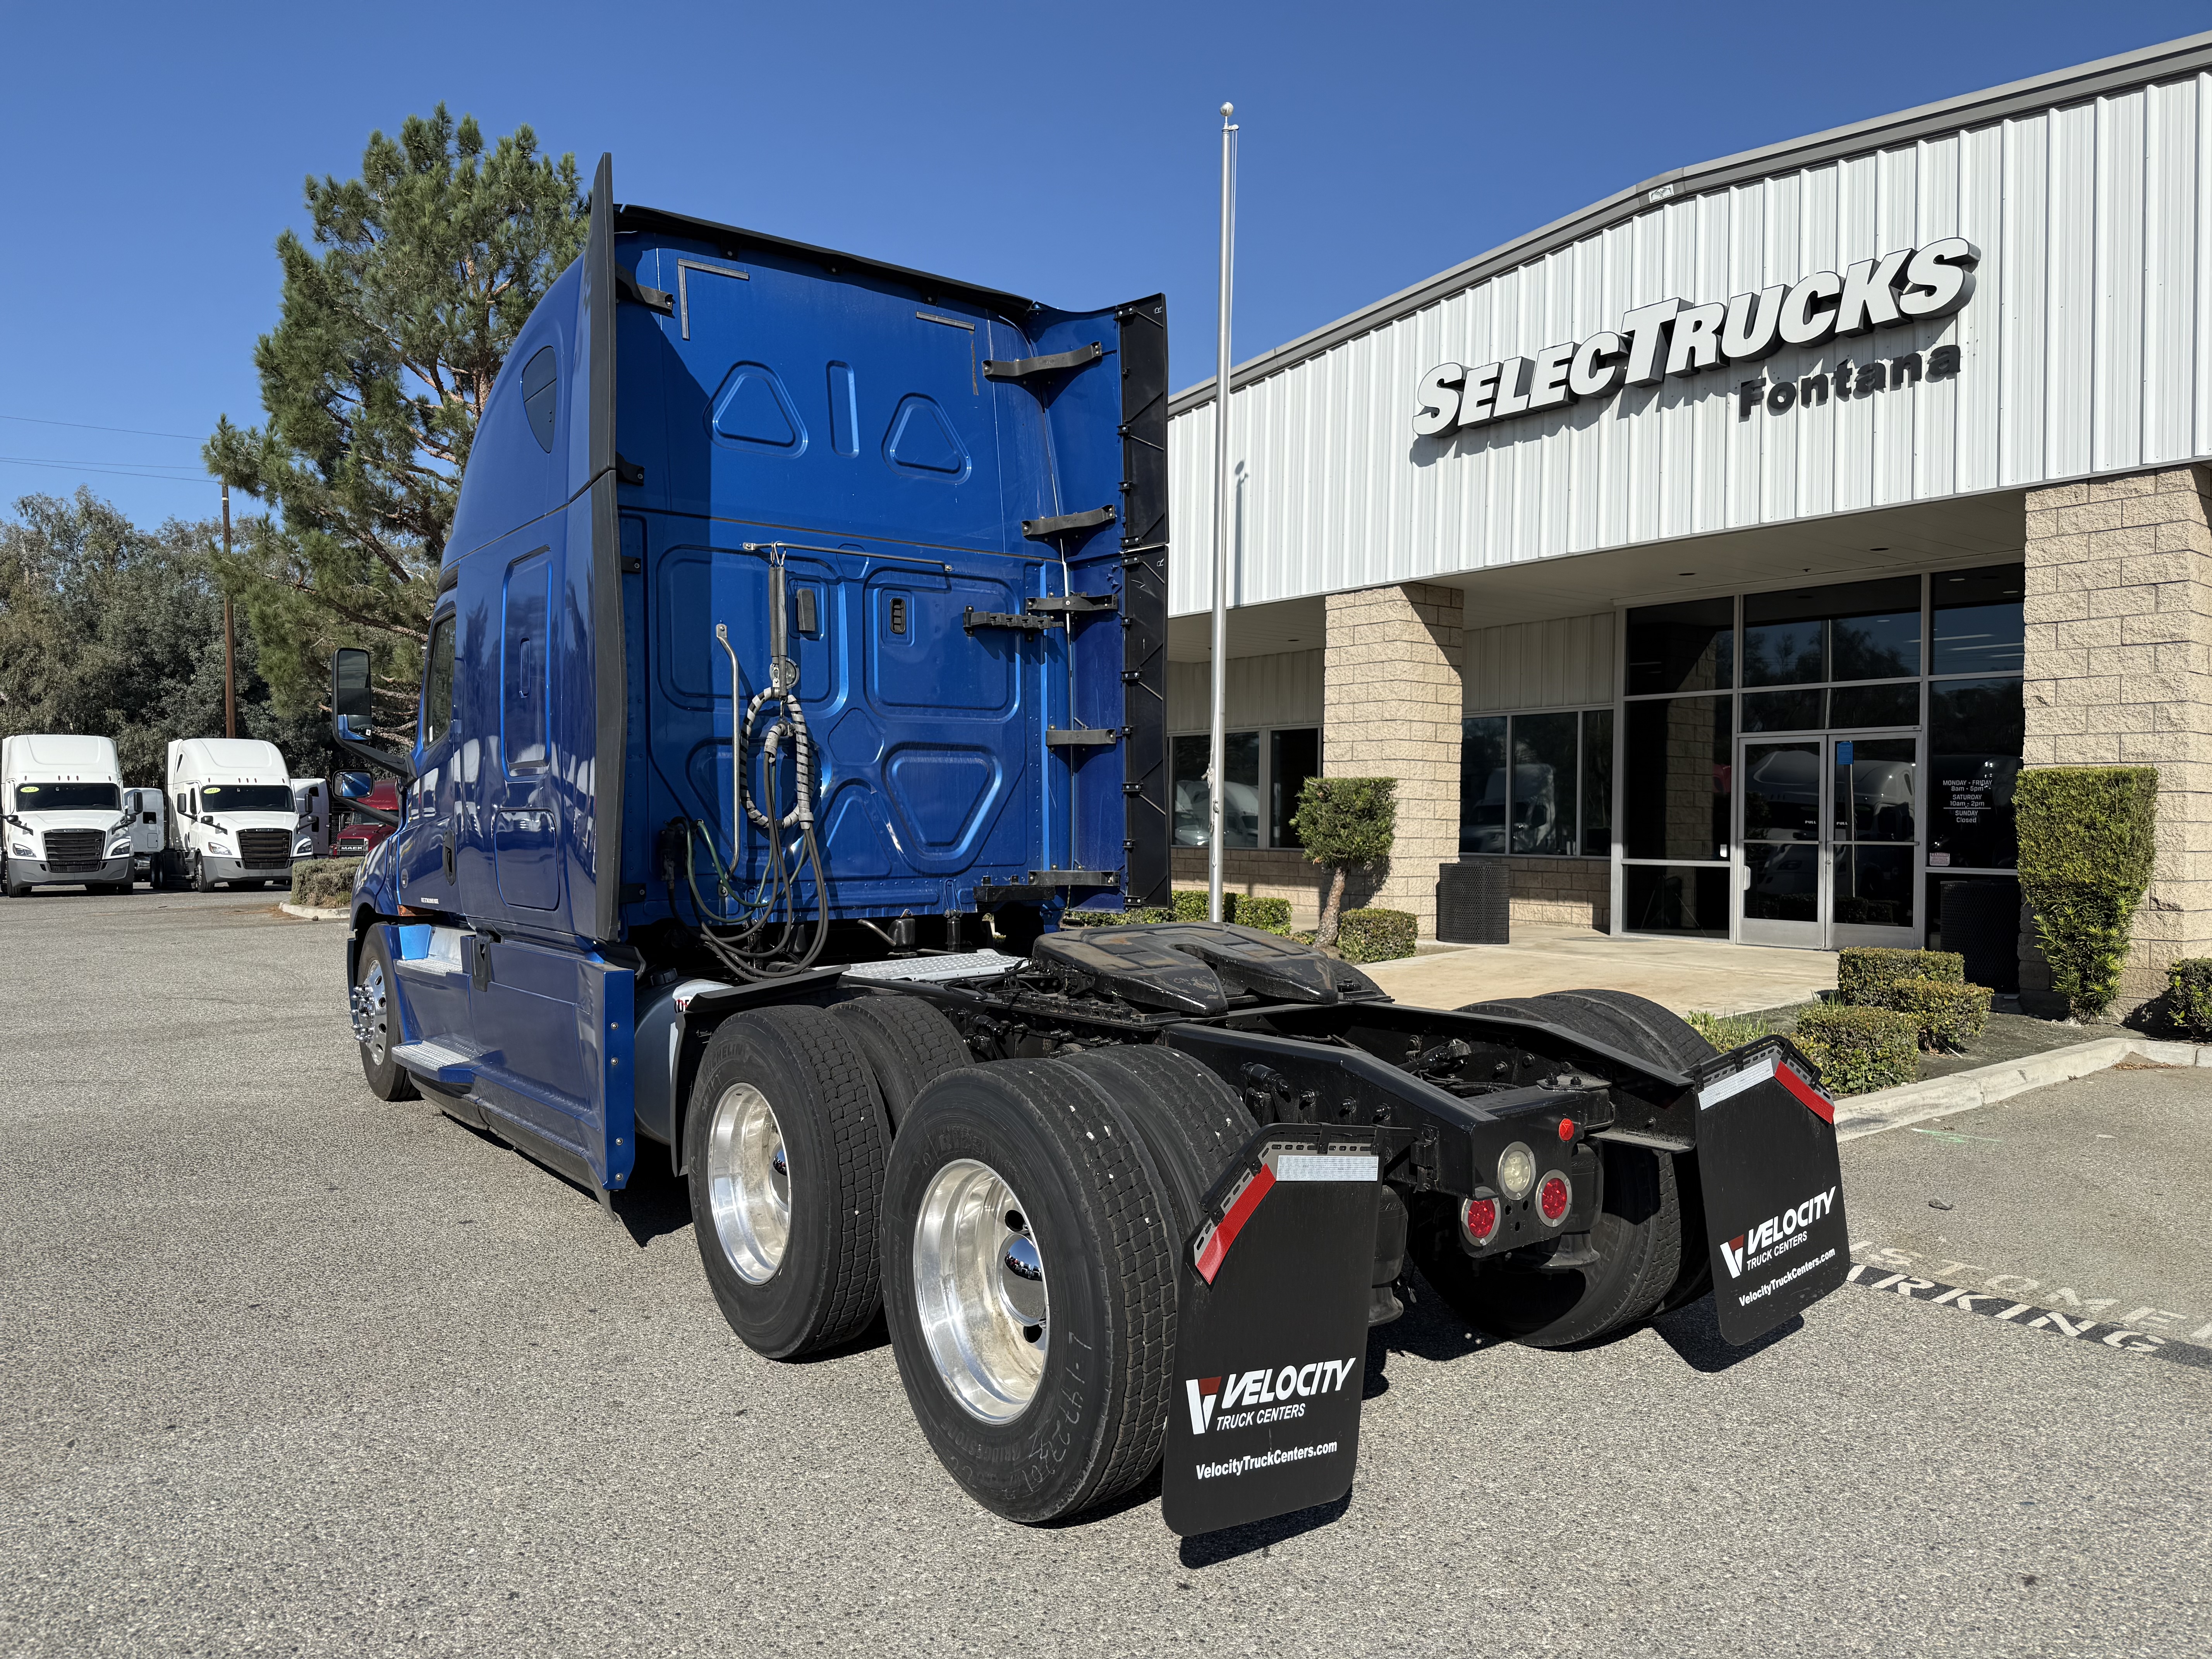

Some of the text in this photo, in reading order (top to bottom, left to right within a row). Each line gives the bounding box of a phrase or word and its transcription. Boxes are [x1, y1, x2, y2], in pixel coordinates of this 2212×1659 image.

[1412, 237, 1981, 438] SELECTRUCKS
[1739, 345, 1961, 417] Fontana
[1748, 1186, 1836, 1255] VELOCITY
[1739, 1248, 1835, 1306] VelocityTruckCenters.com
[1747, 1231, 1807, 1271] TRUCK CENTERS
[1846, 1265, 2165, 1352] RKING
[1222, 1357, 1356, 1409] VELOCITY
[1217, 1403, 1305, 1431] TRUCK CENTERS
[1196, 1441, 1337, 1479] VelocityTruckCenters.com
